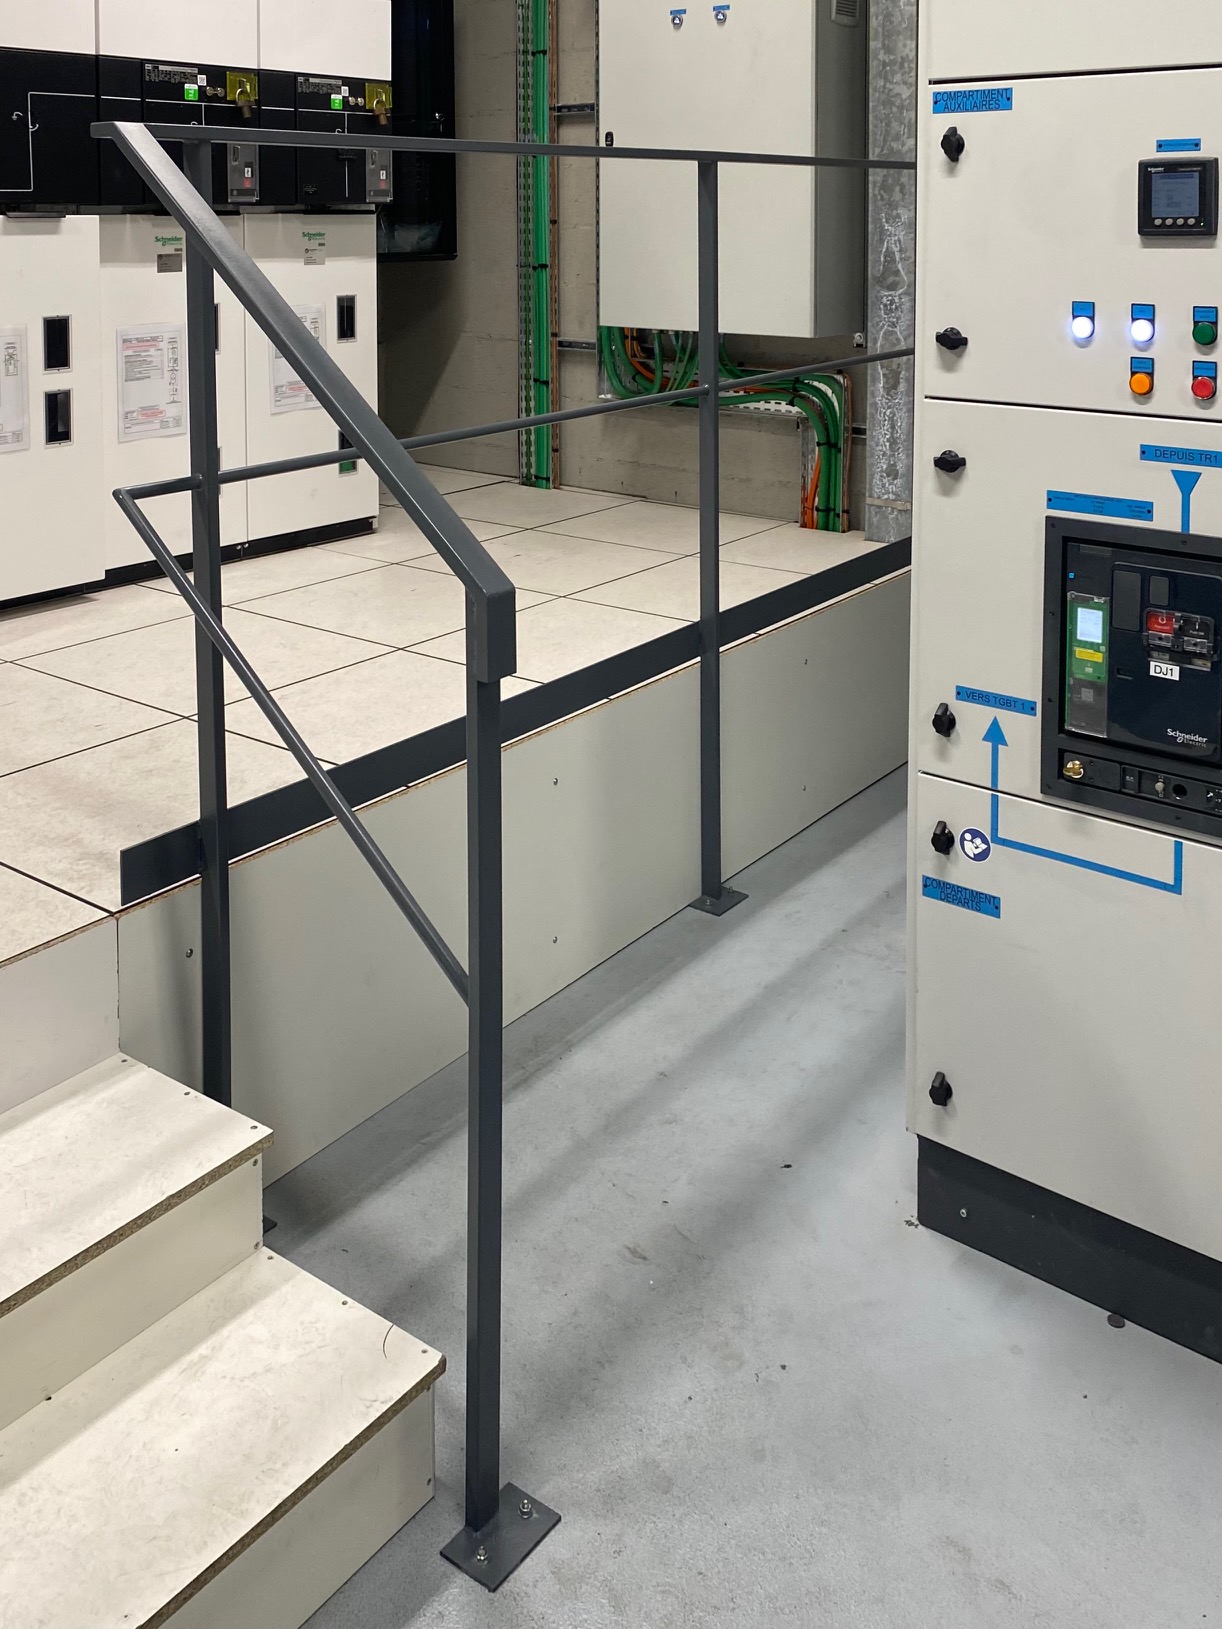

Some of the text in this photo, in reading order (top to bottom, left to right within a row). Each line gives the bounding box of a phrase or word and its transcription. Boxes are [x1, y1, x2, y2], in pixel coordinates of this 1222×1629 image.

[935, 89, 1009, 102] COMPARTIMENT
[943, 99, 1001, 112] AUXILIAIRES
[1154, 449, 1218, 463] DEPUIS TR1
[1154, 665, 1174, 677] DJ1
[965, 691, 1025, 710] VERS TGBT 1
[1166, 728, 1208, 743] Schneider
[924, 877, 996, 906] COMPARTIMENT
[940, 891, 982, 912] DEPARTS
